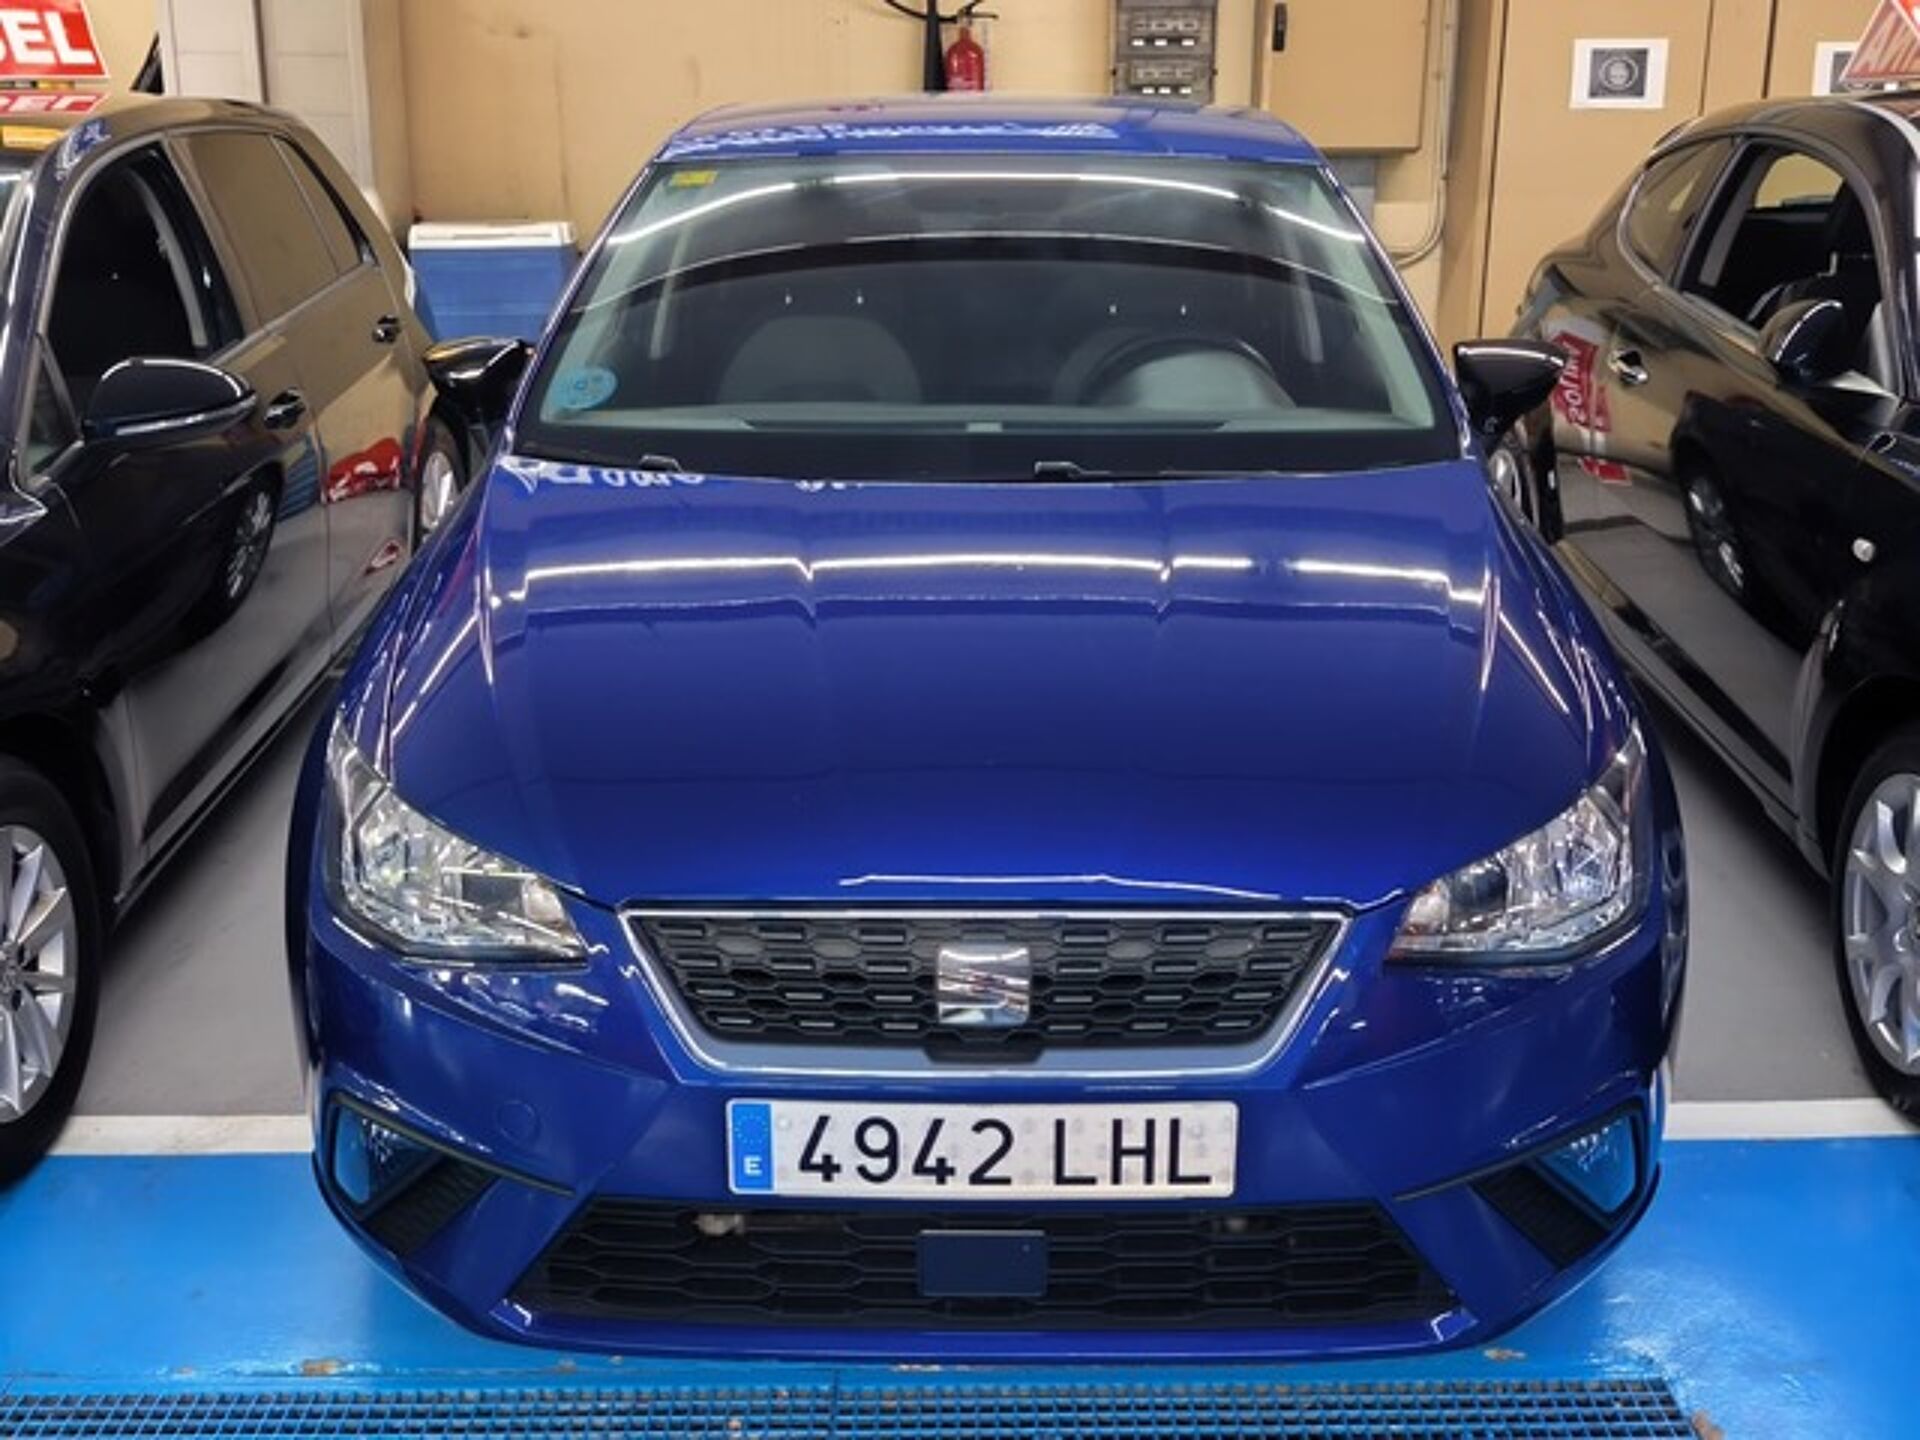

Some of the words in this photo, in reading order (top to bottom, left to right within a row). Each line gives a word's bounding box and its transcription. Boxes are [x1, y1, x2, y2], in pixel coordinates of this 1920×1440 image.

[744, 1156, 762, 1176] E
[798, 1114, 1014, 1186] 4942
[1054, 1118, 1213, 1186] LHL
